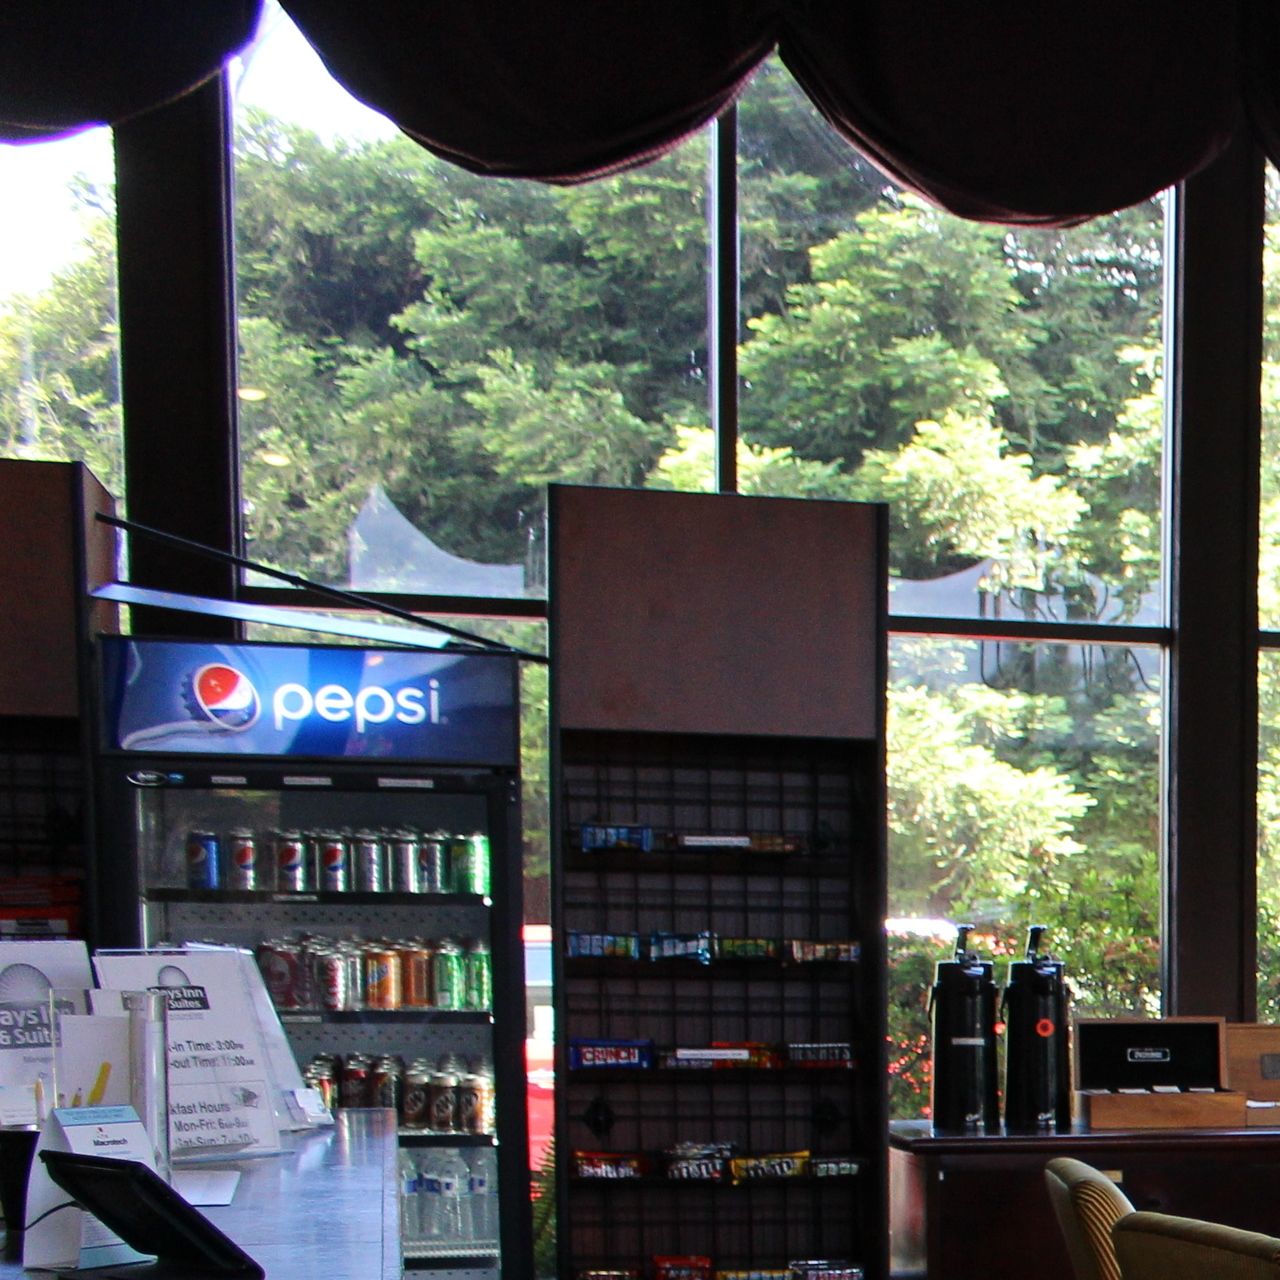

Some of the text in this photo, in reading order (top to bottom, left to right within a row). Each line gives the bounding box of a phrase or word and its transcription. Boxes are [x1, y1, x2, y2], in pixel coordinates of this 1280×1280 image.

[273, 679, 441, 734] pepsi
[0, 1008, 38, 1027] ays
[187, 1041, 213, 1052] Time:
[580, 1047, 639, 1064] CRUNCH
[202, 1101, 231, 1112] Hours
